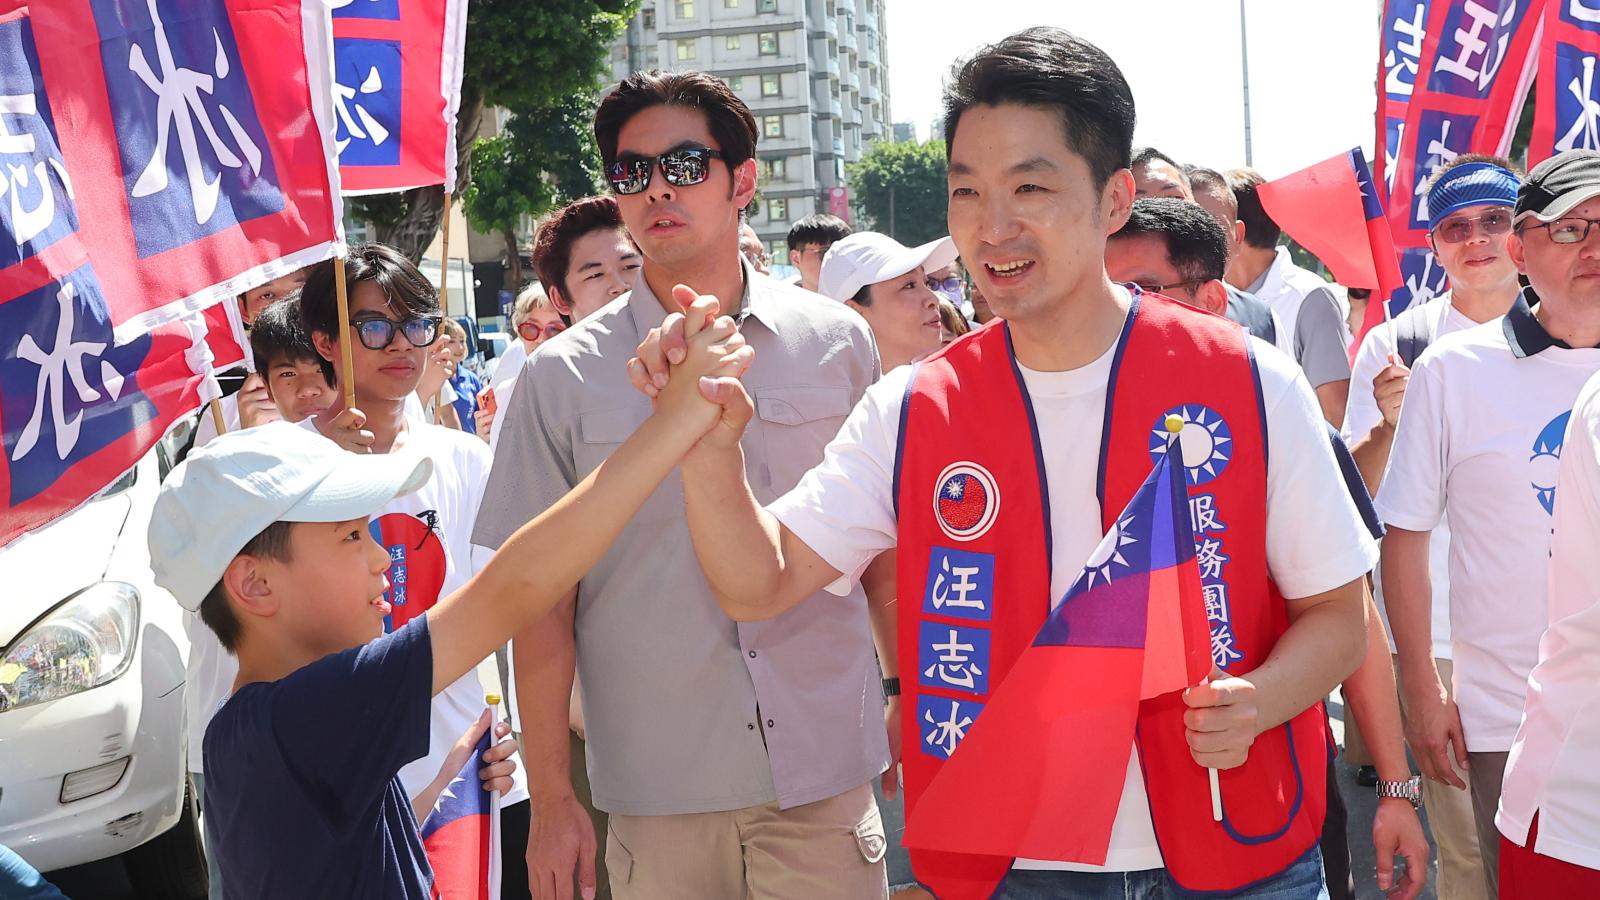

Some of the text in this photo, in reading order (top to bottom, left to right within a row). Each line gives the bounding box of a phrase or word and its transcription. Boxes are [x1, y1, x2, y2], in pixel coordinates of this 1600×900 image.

[391, 547, 406, 603] 汪志冰
[924, 555, 985, 757] 汪志冰
